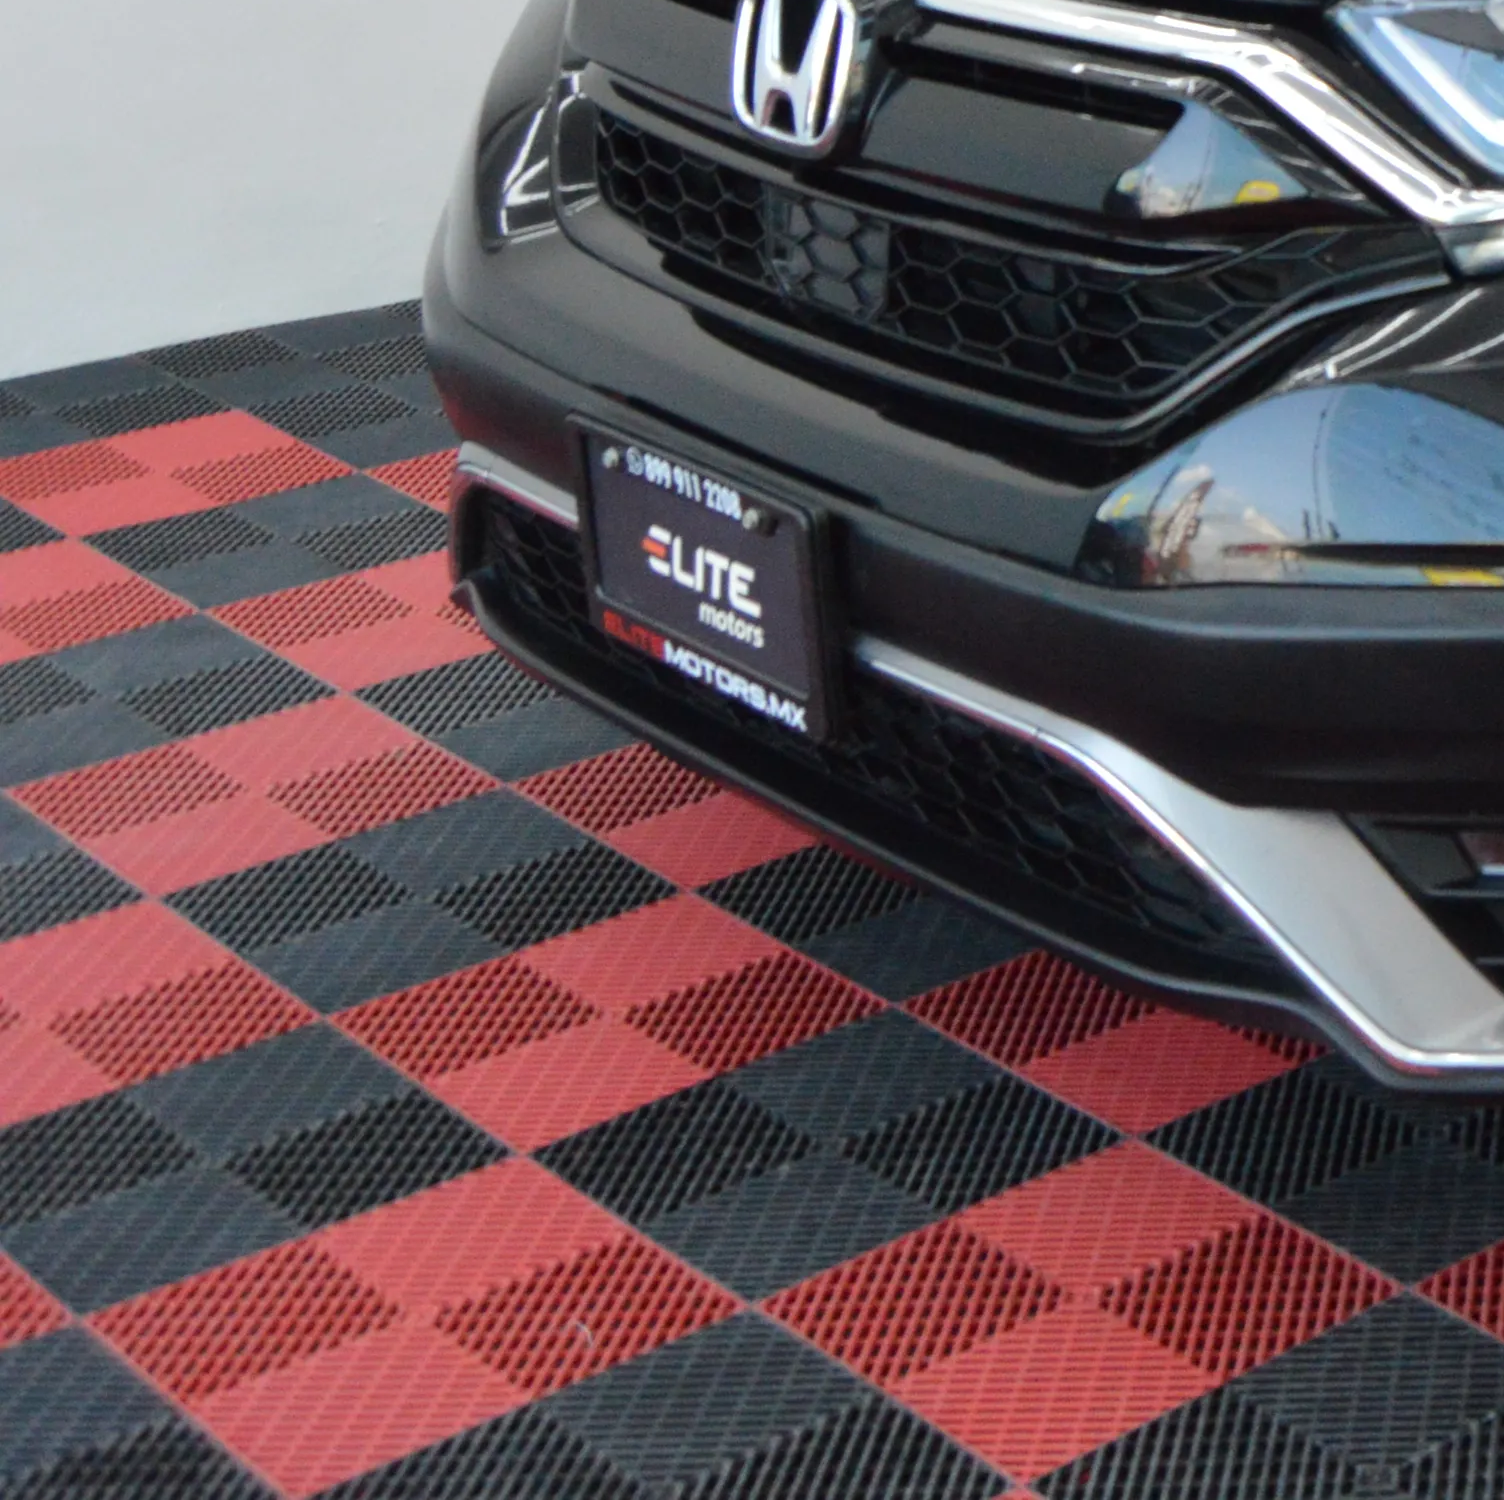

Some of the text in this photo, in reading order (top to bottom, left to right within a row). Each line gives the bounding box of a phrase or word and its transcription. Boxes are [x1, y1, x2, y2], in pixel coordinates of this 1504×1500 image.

[673, 465, 701, 503] 911
[641, 524, 762, 619] ELITE
[699, 601, 764, 648] motors
